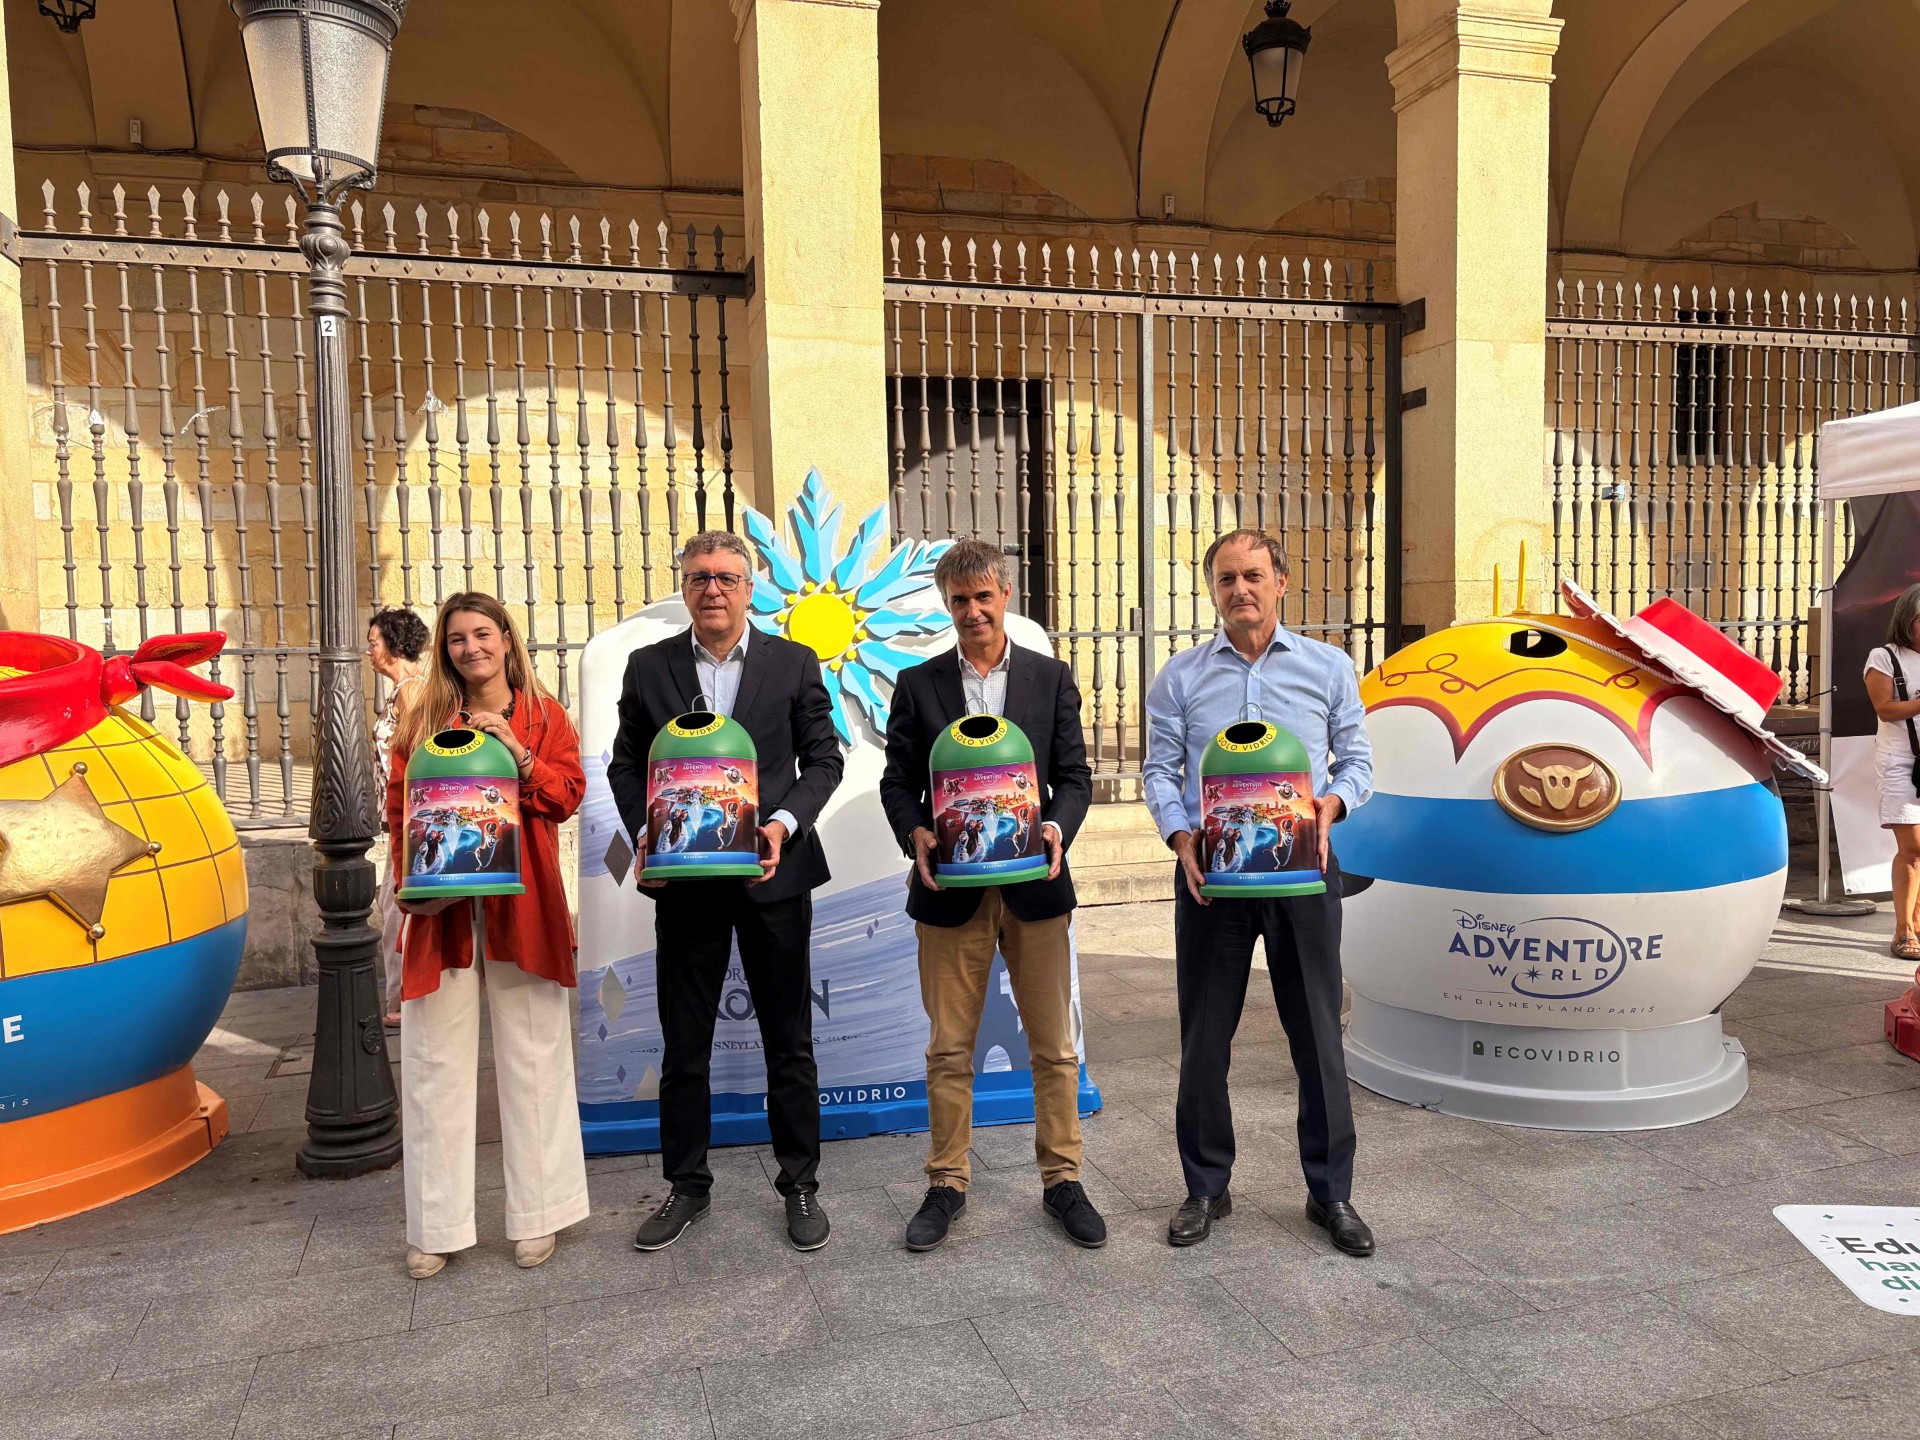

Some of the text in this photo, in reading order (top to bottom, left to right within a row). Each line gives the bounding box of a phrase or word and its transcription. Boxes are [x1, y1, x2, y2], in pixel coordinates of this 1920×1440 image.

[323, 320, 333, 333] 2
[689, 721, 720, 736] VIDRIO
[953, 727, 1006, 746] SOLO VIDRIO
[449, 739, 481, 755] VIDRIO
[1218, 733, 1273, 751] SOLO VIDRIO
[1448, 931, 1664, 962] ADVENTURE
[1443, 992, 1463, 1001] EN
[1608, 1005, 1656, 1014] PARIS
[712, 1040, 764, 1050] SNEYLA
[1494, 1045, 1620, 1063] ECOVIDRIO
[818, 1086, 906, 1105] OVIDRIO
